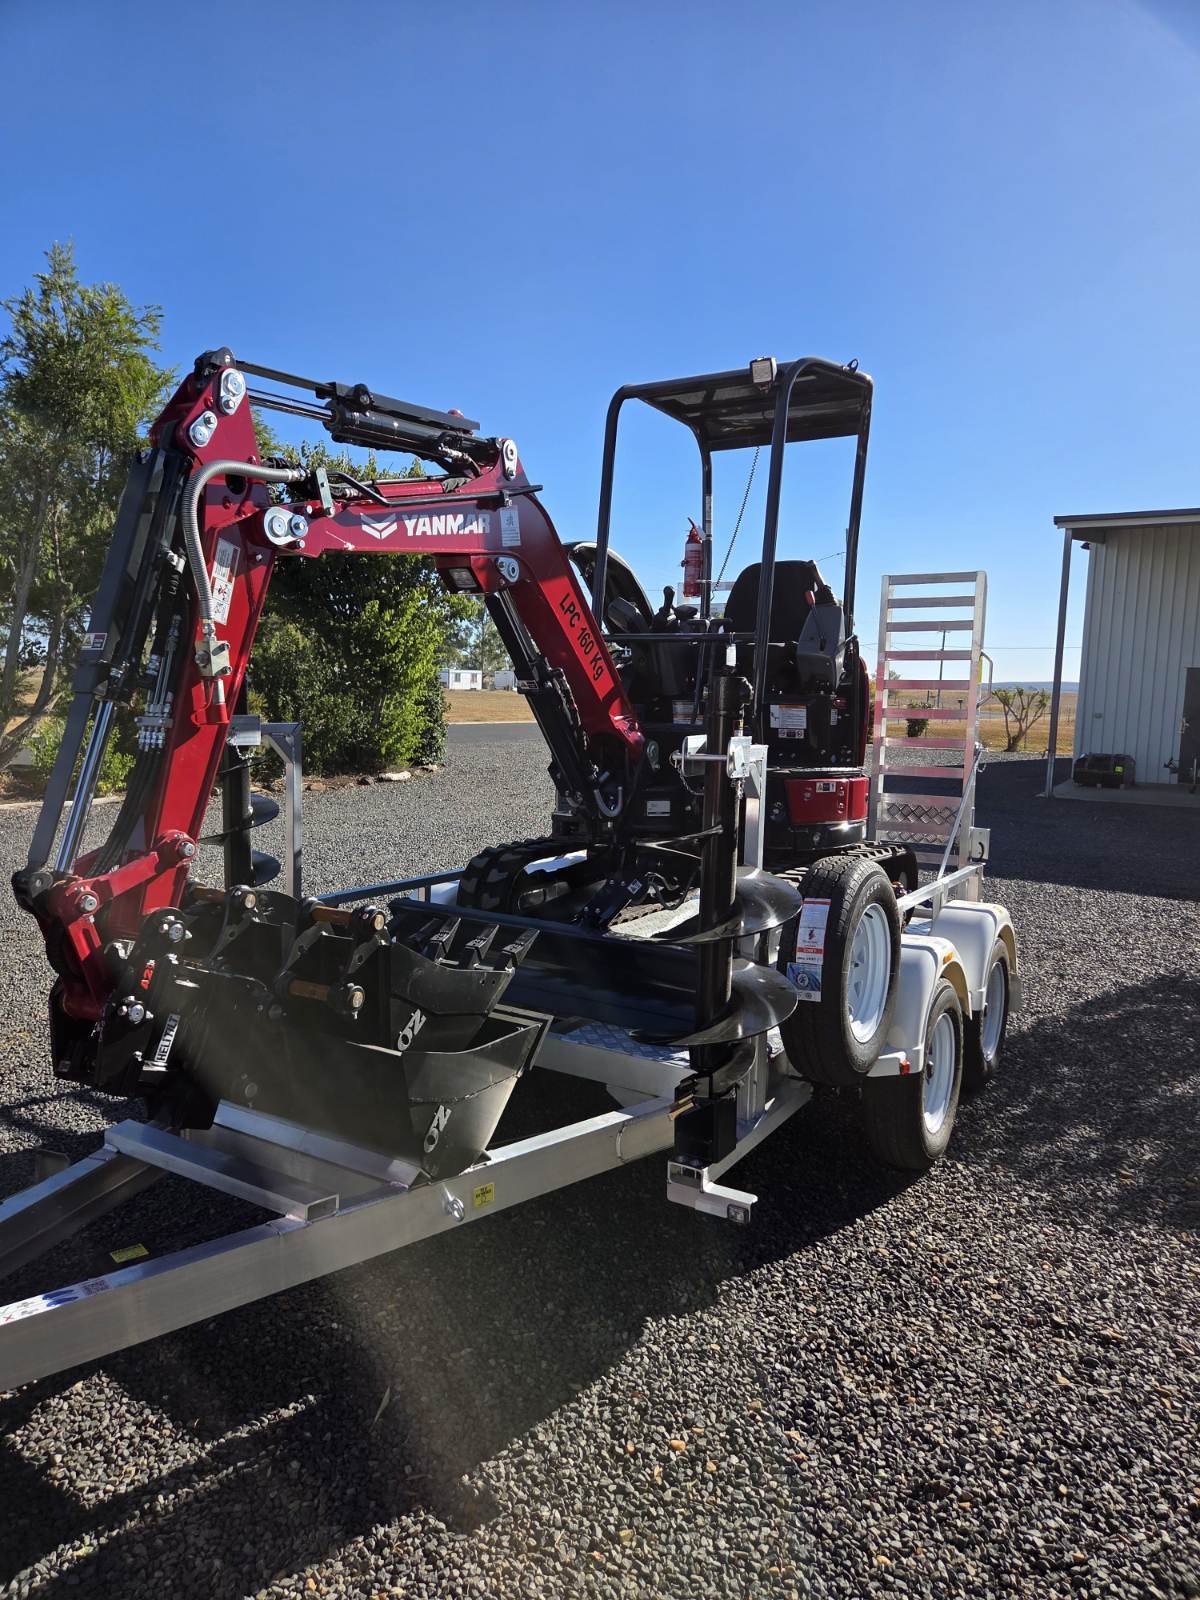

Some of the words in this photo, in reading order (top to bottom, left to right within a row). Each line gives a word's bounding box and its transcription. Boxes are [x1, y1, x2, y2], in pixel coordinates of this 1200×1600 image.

[402, 514, 490, 537] YANMAR
[559, 593, 581, 628] LPC
[577, 627, 595, 656] 160
[590, 651, 604, 681] Kg
